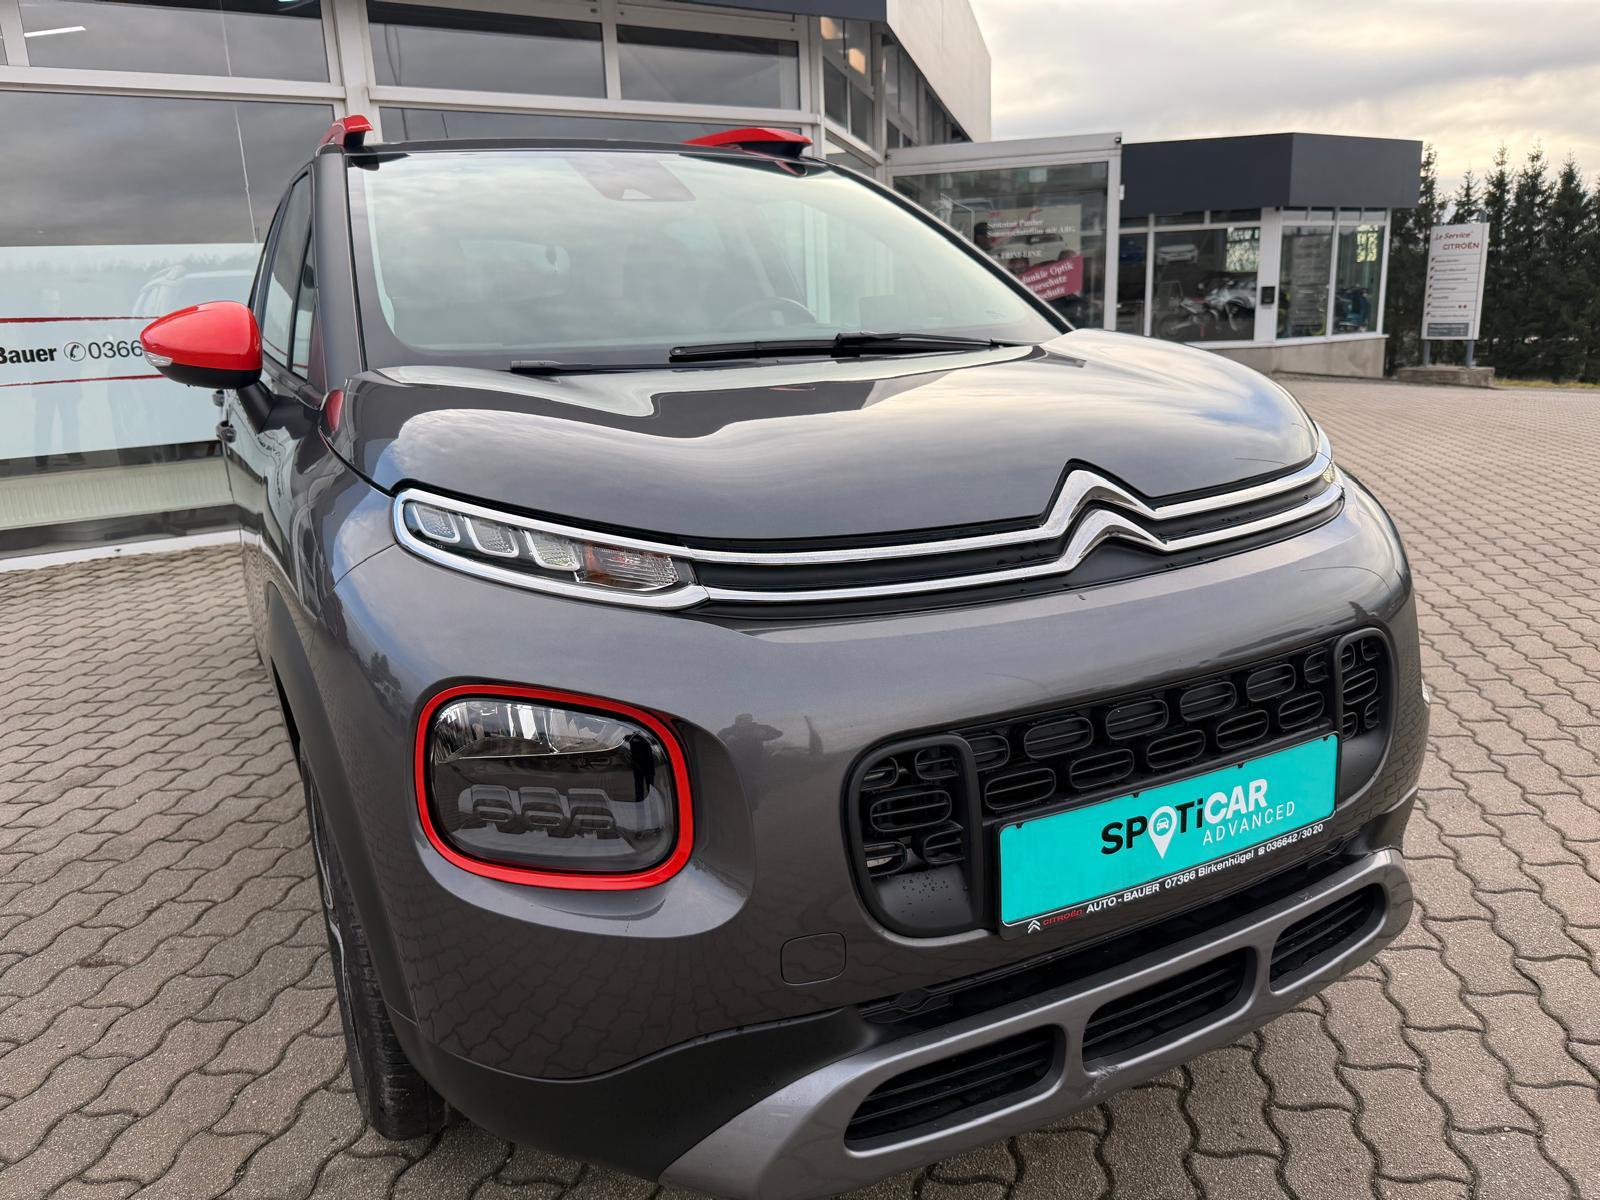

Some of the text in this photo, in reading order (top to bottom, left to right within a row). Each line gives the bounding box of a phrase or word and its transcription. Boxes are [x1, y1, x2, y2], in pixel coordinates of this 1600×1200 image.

[1444, 231, 1471, 239] Service
[1442, 241, 1480, 250] CITROËN
[1050, 262, 1074, 277] Optik
[1202, 801, 1295, 846] ADVANCED
[1164, 870, 1196, 889] 07366
[1198, 852, 1254, 877] Birkenhügel
